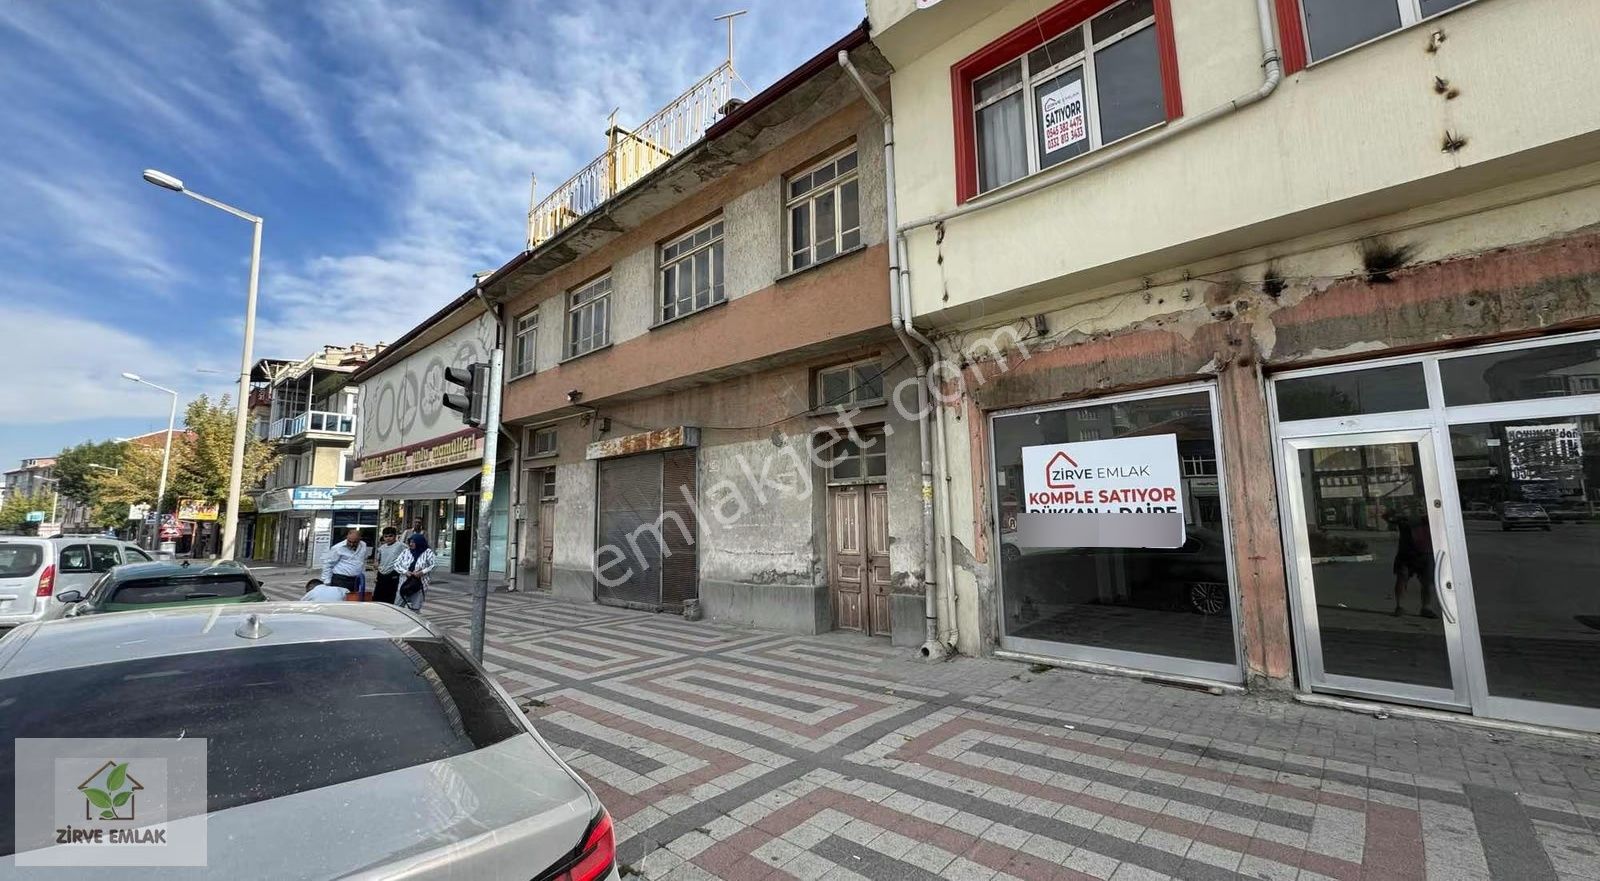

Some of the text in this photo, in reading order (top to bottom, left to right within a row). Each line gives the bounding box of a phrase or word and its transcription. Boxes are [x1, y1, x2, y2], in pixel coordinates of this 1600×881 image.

[1045, 100, 1081, 128] SATIYORR
[1060, 121, 1069, 134] 382
[1052, 465, 1150, 481] ZİRVE EMLAK
[1029, 487, 1176, 505] KOMPLE SATIYOR
